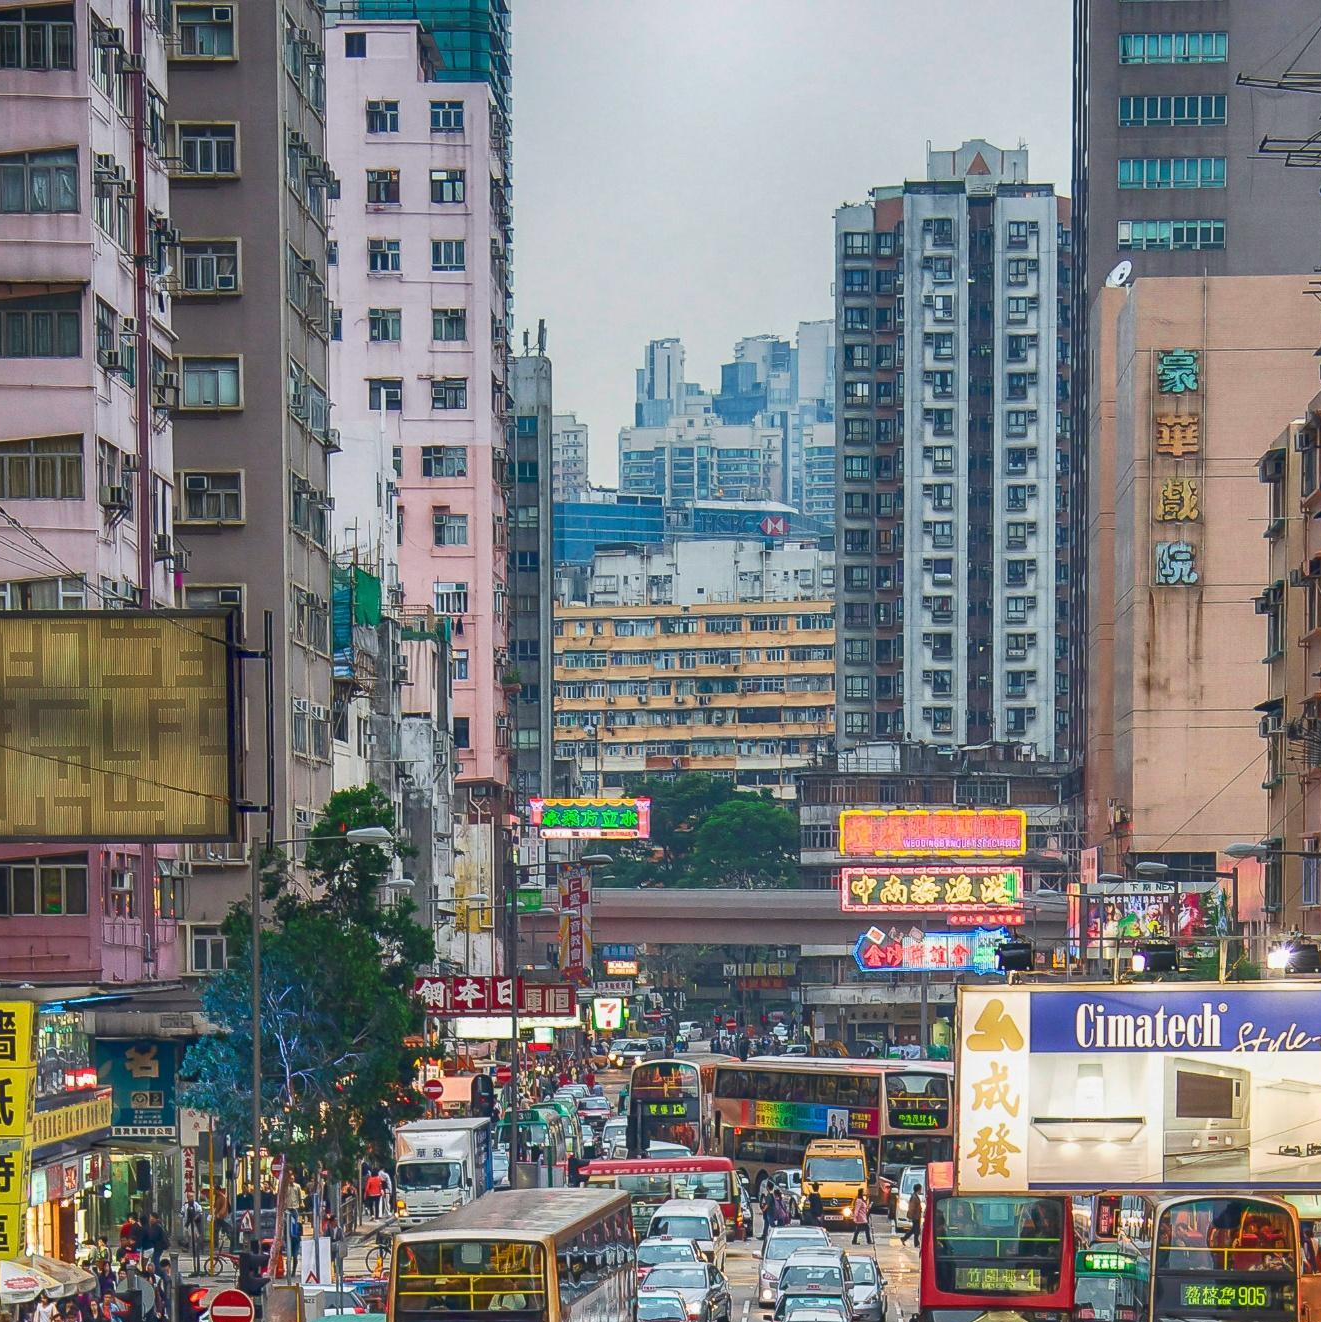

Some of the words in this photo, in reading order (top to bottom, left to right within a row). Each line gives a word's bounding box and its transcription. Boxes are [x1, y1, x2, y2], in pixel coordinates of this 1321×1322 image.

[1076, 1003, 1222, 1048] Cimatech
[967, 1060, 1021, 1179] 成發
[1185, 1285, 1236, 1300] 荔枝角
[1238, 1286, 1267, 1306] 905
